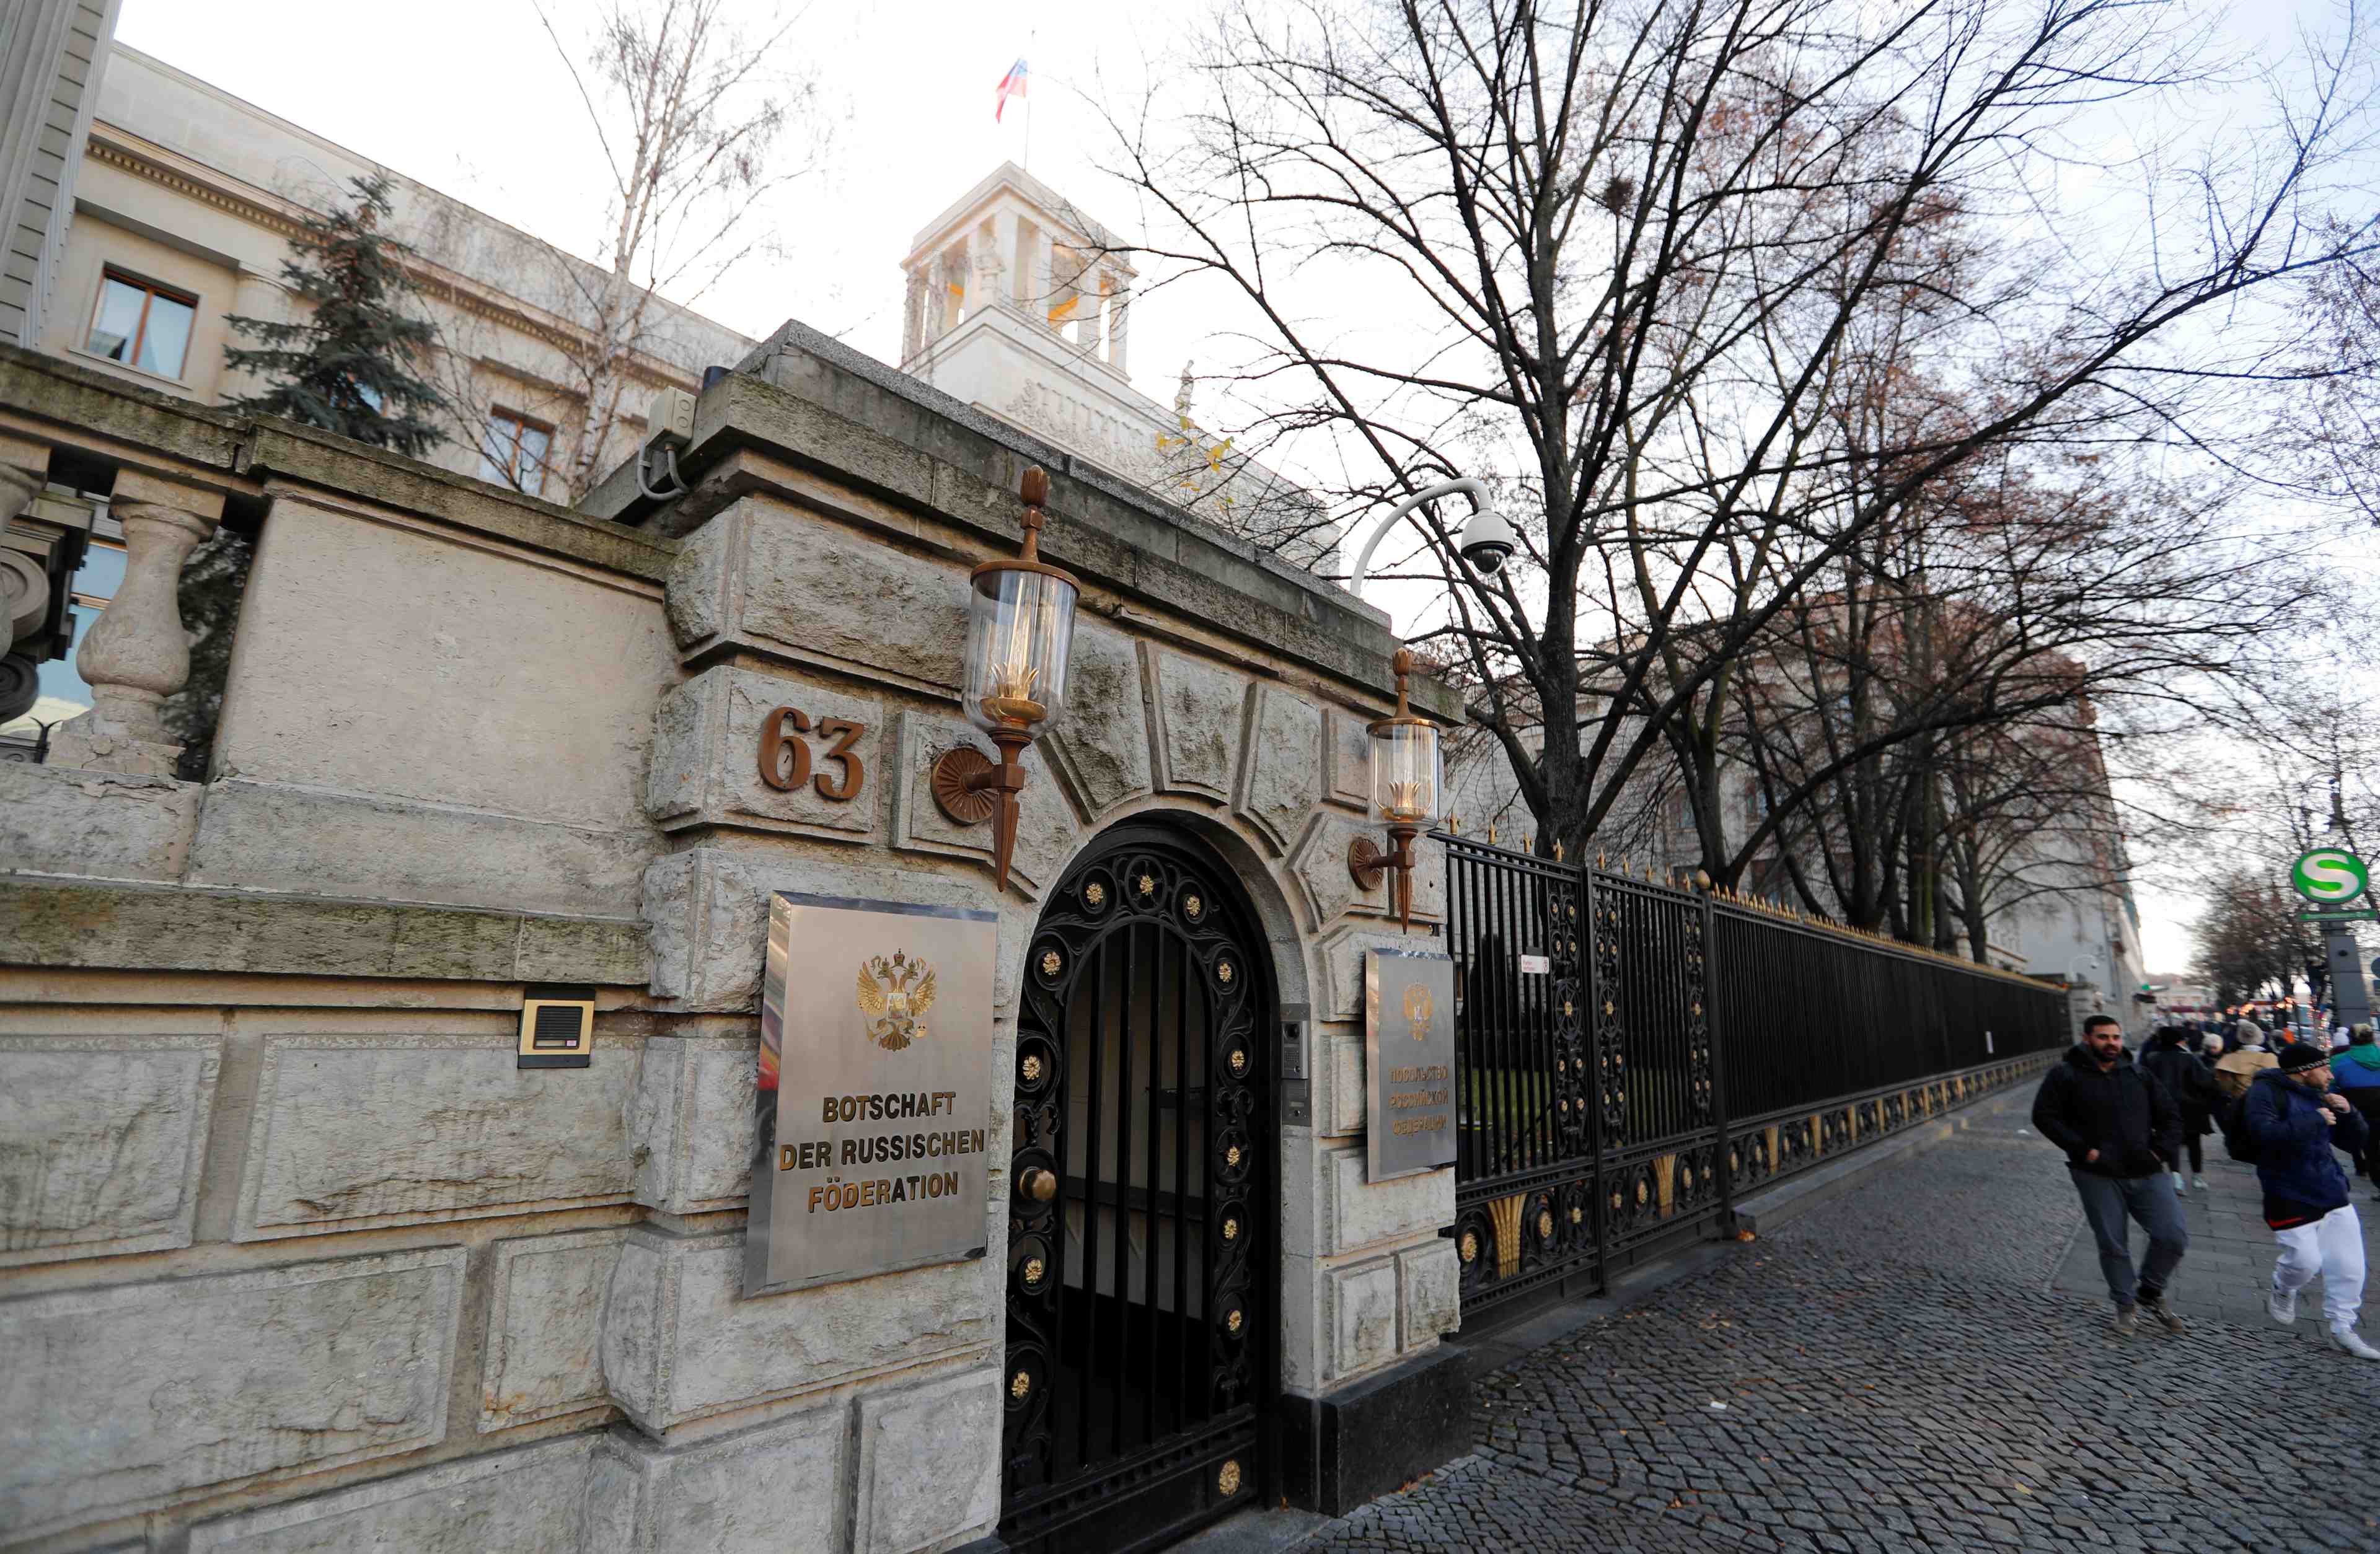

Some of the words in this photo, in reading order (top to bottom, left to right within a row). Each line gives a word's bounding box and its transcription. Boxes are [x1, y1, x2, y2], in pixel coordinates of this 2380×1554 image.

[758, 706, 865, 802] 63
[2300, 853, 2360, 899] S
[822, 1091, 956, 1123] BOTSCHAFT
[779, 1141, 832, 1171] DER
[840, 1129, 985, 1165] RUSSISCHEN
[808, 1171, 958, 1213] FÖDERATION
